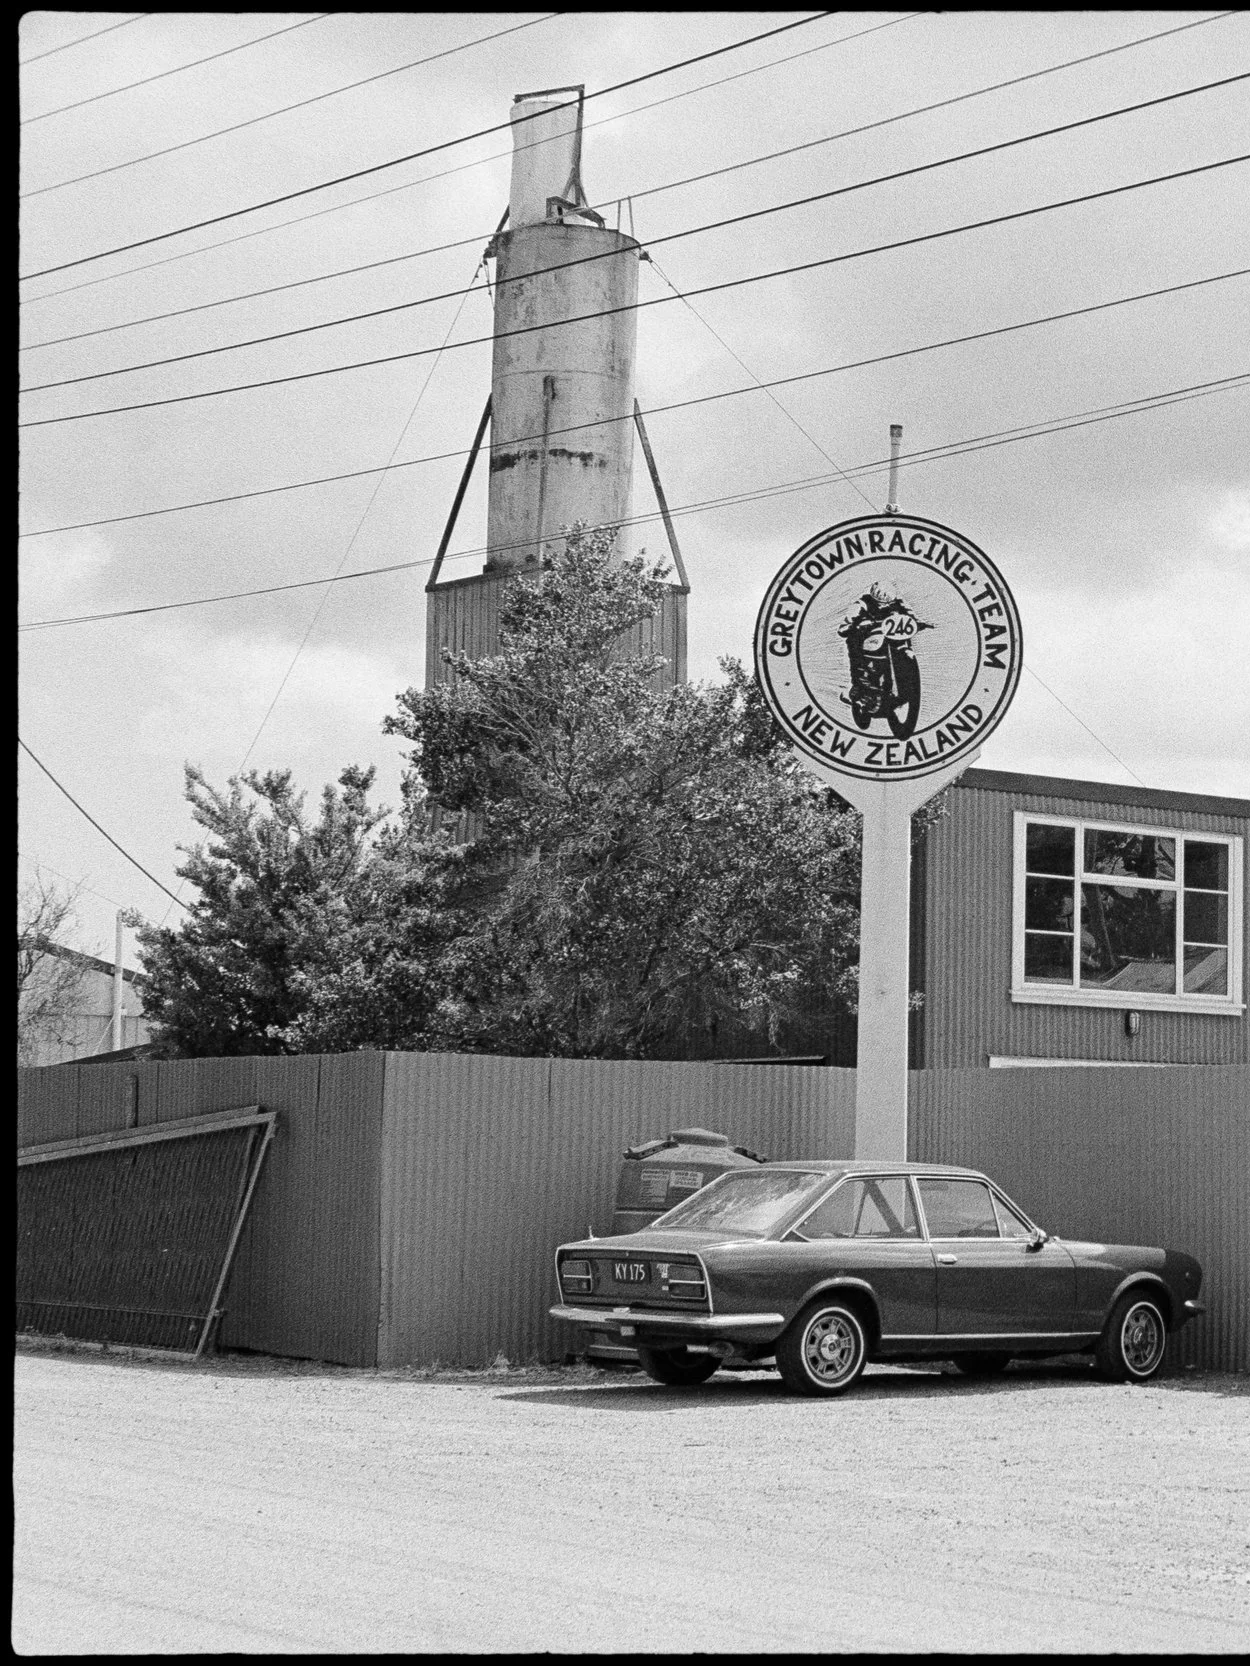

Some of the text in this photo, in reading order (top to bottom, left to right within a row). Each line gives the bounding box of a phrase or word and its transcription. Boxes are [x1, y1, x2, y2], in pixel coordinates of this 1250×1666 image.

[769, 530, 1007, 669] GREYTOWN RACING TEAM
[885, 617, 914, 635] 246
[792, 704, 983, 765] NEW ZEALAND
[614, 1263, 646, 1281] KY 175
